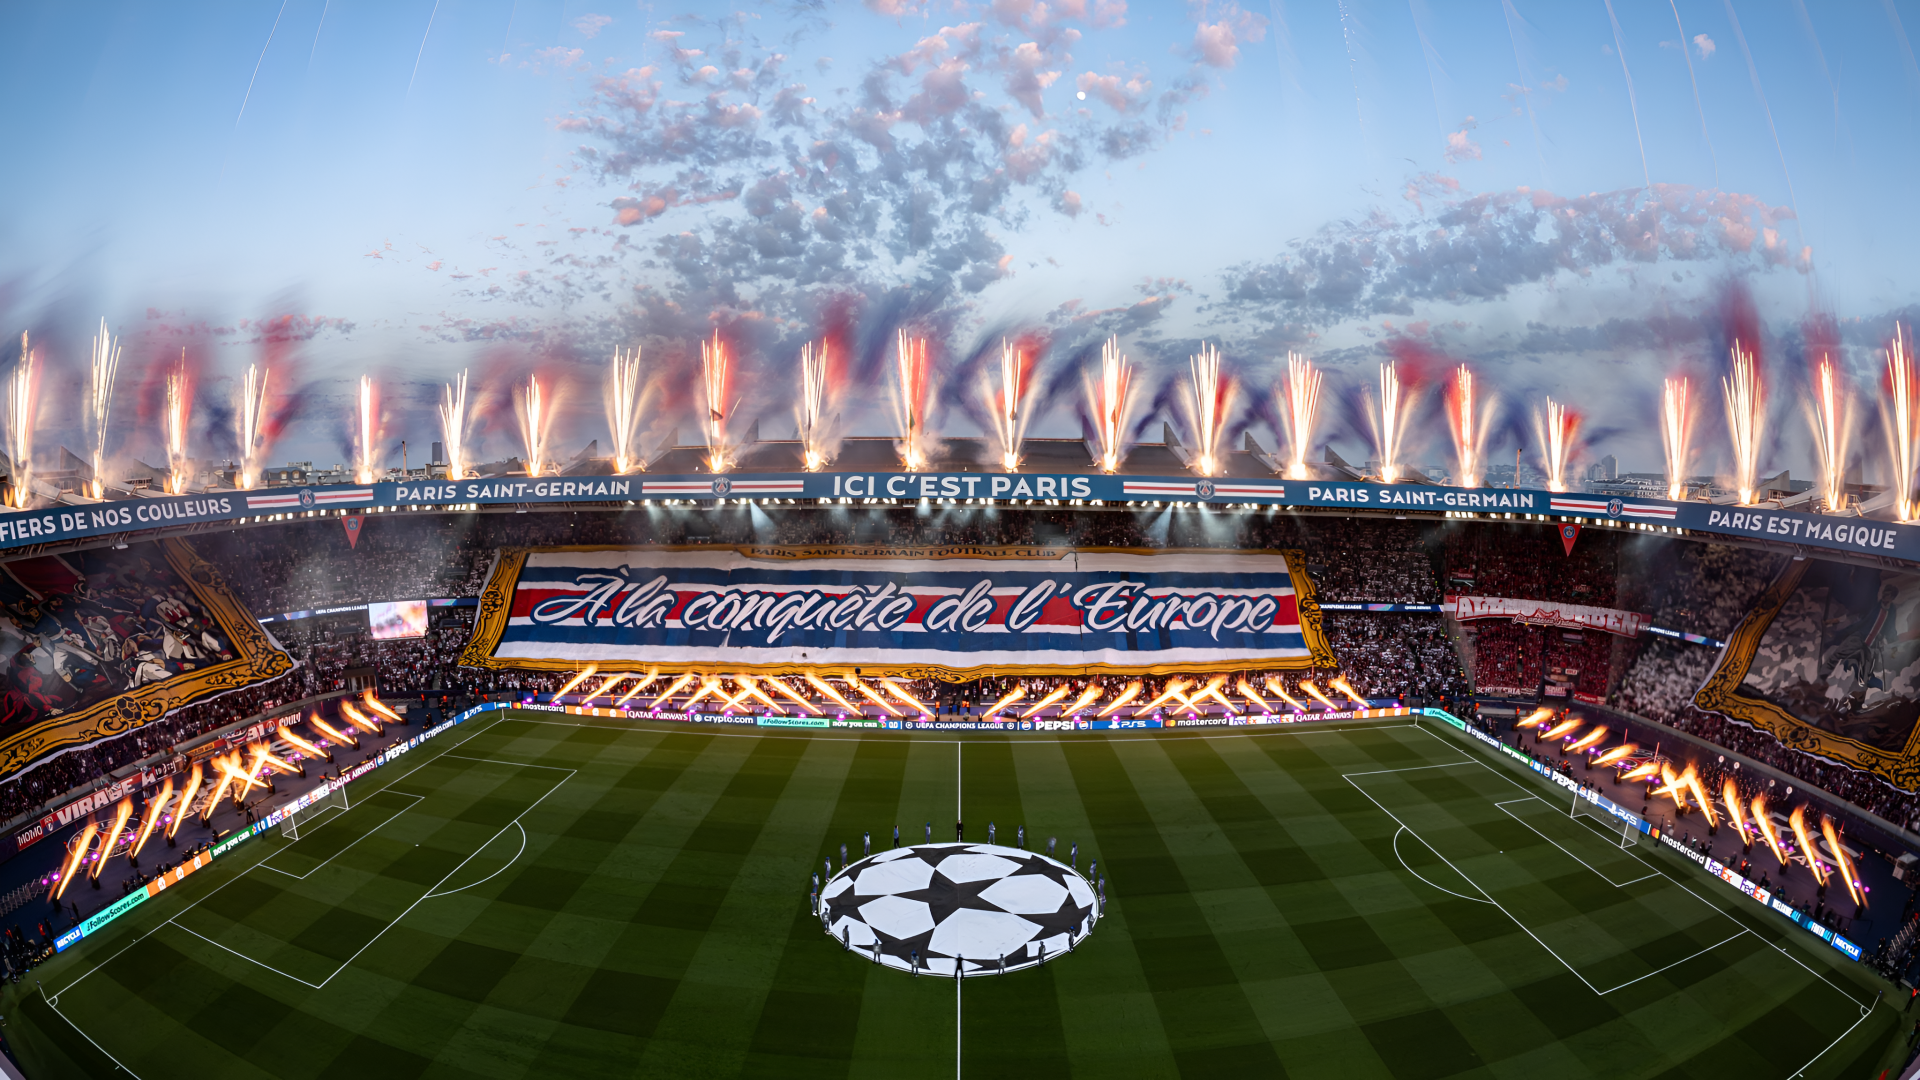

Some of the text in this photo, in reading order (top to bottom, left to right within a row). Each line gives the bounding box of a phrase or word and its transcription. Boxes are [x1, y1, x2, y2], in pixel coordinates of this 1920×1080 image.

[396, 481, 630, 501] PARIS SAINT-GERMAIN
[834, 475, 875, 496] ICI
[991, 477, 1091, 497] PARIS
[1308, 487, 1534, 508] PARIS SAINT-GERMAIN
[0, 498, 232, 541] FIERS DE NOS COULEURS
[1708, 510, 1897, 550] PARIS EST MAGIQUE
[750, 547, 1057, 557] PARIS SAINT-GERMAIN FOOTBALL CLUB
[533, 564, 628, 624] À
[615, 575, 675, 627] la
[681, 581, 914, 644] conquête
[926, 579, 992, 632] de
[469, 704, 483, 716] PS5
[522, 702, 564, 713] mastercard
[628, 710, 688, 721] QATAR AIRWAYS
[1296, 711, 1352, 722] QATAR AIRWAYS
[425, 719, 454, 740] crypto.com
[704, 715, 754, 725] crypto.com
[915, 721, 934, 729] UEFA
[935, 721, 976, 729] CHAMPIONS
[1035, 722, 1075, 731] PEPSI
[1120, 720, 1147, 728] PS5
[1177, 717, 1228, 726] mastercard
[1471, 728, 1500, 749] crypto.com
[385, 743, 410, 762] PEPSI
[330, 770, 351, 791] QATAR
[351, 760, 375, 779] AIRWAYS
[1552, 770, 1578, 793] PEPSI
[56, 778, 136, 826] VIRAGE
[213, 830, 251, 856] now you can
[1661, 833, 1706, 865] mastercard
[55, 929, 81, 950] RECYCLE
[1834, 936, 1860, 958] RECYCLE
